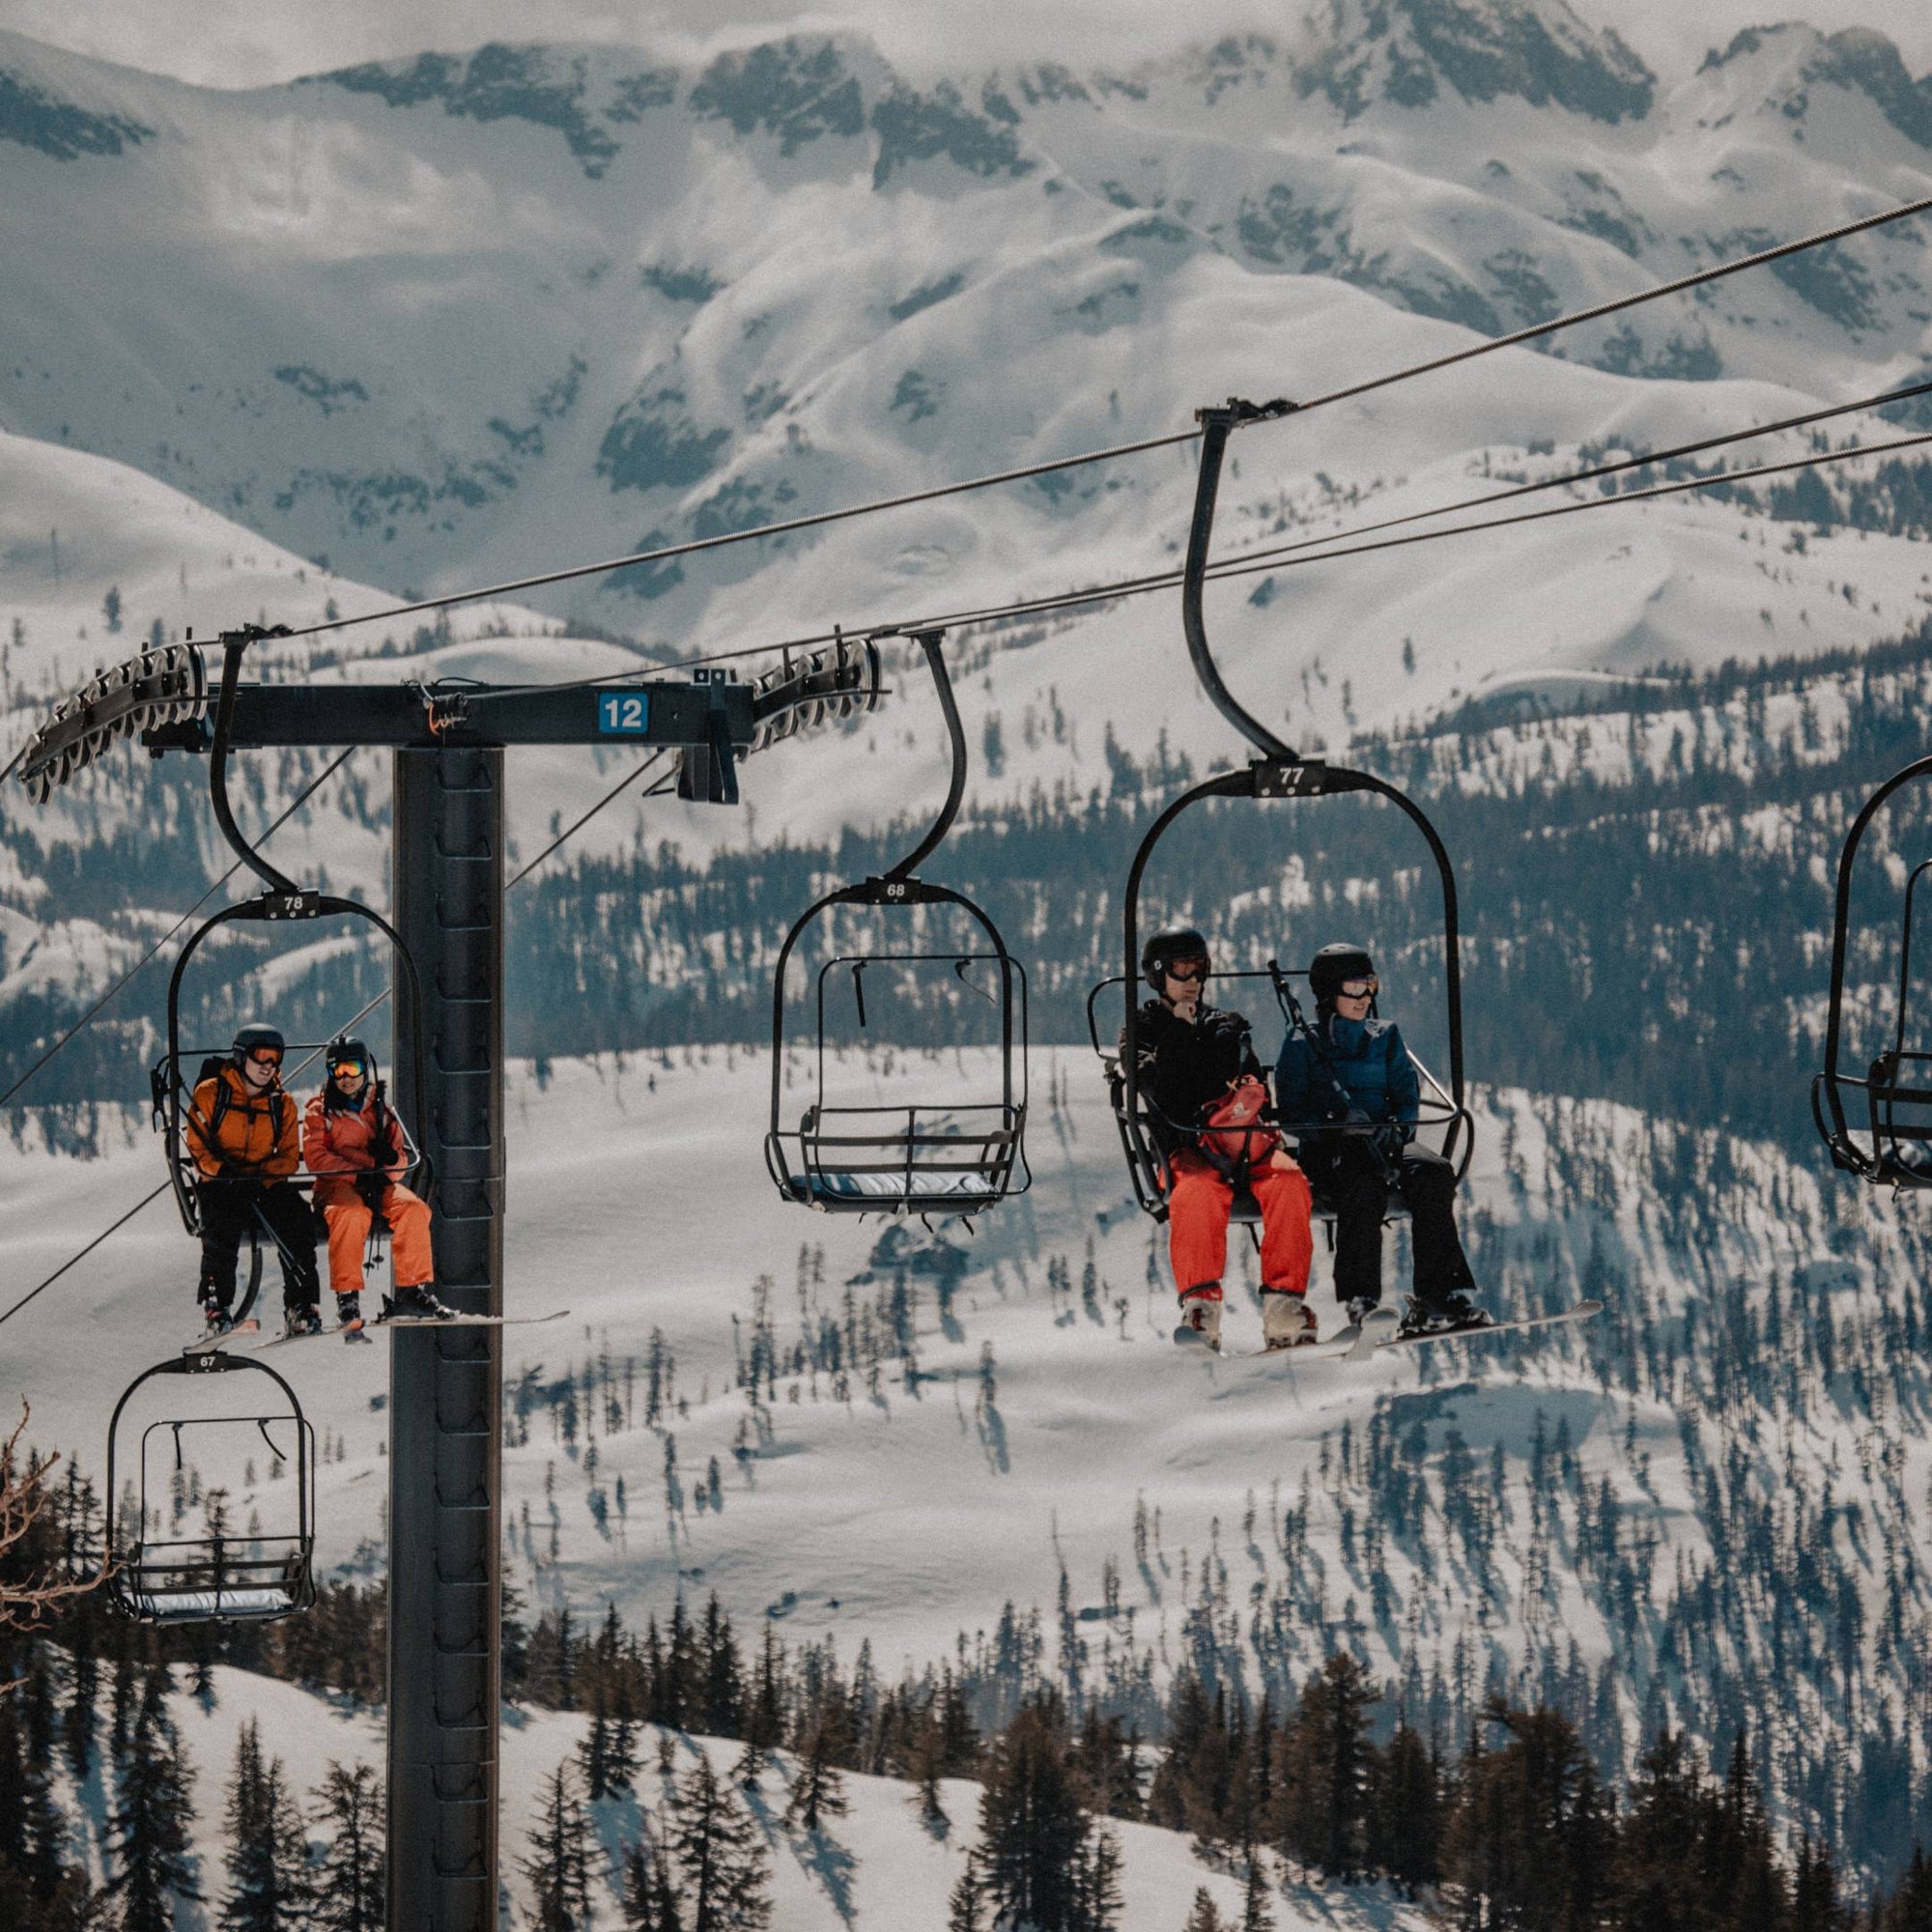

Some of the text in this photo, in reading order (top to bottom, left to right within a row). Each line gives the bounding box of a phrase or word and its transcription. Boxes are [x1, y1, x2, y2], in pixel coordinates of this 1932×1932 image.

[605, 698, 641, 726] 12
[1280, 768, 1305, 783] 77
[887, 884, 905, 896] 68
[284, 896, 303, 909] 78
[200, 1356, 215, 1367] 67
